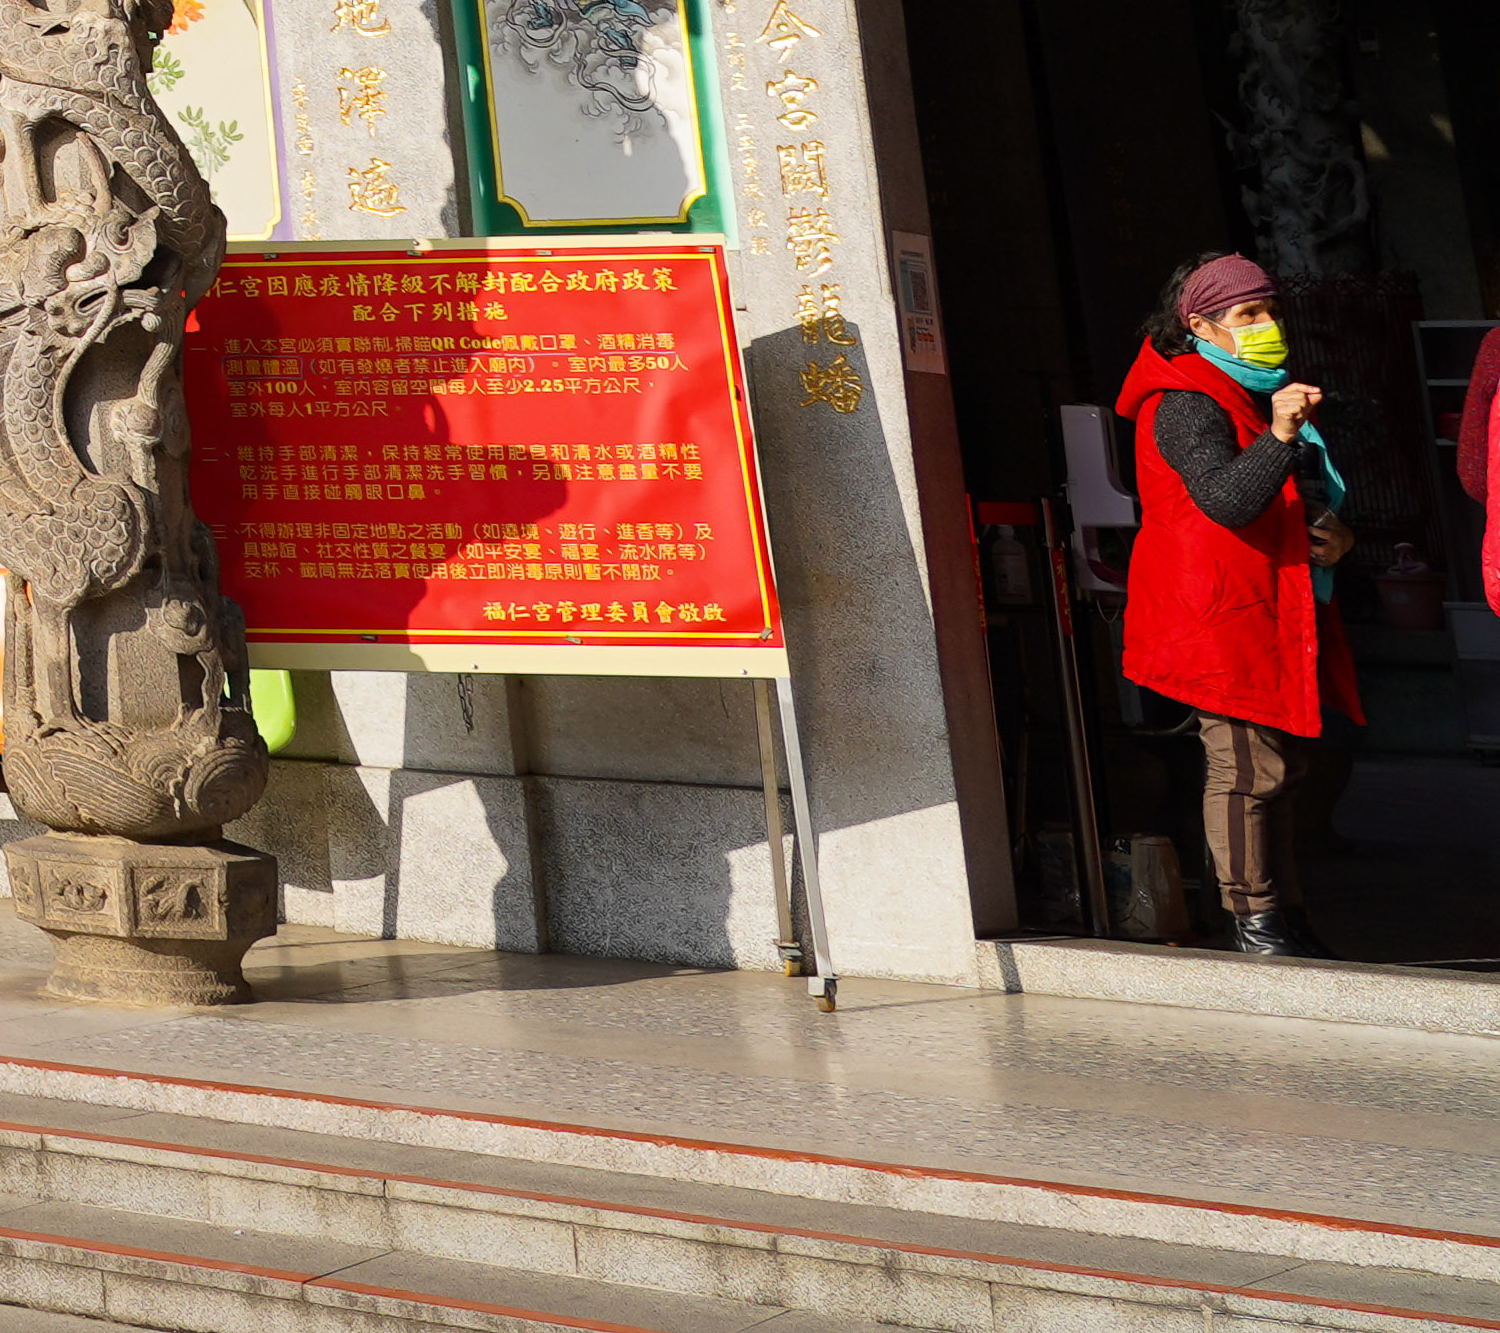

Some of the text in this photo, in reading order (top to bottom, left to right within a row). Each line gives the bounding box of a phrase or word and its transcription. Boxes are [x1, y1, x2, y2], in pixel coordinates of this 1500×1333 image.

[352, 301, 509, 323] 配合下列措施
[482, 601, 727, 624] 福仁宮管理委員會敬啟
